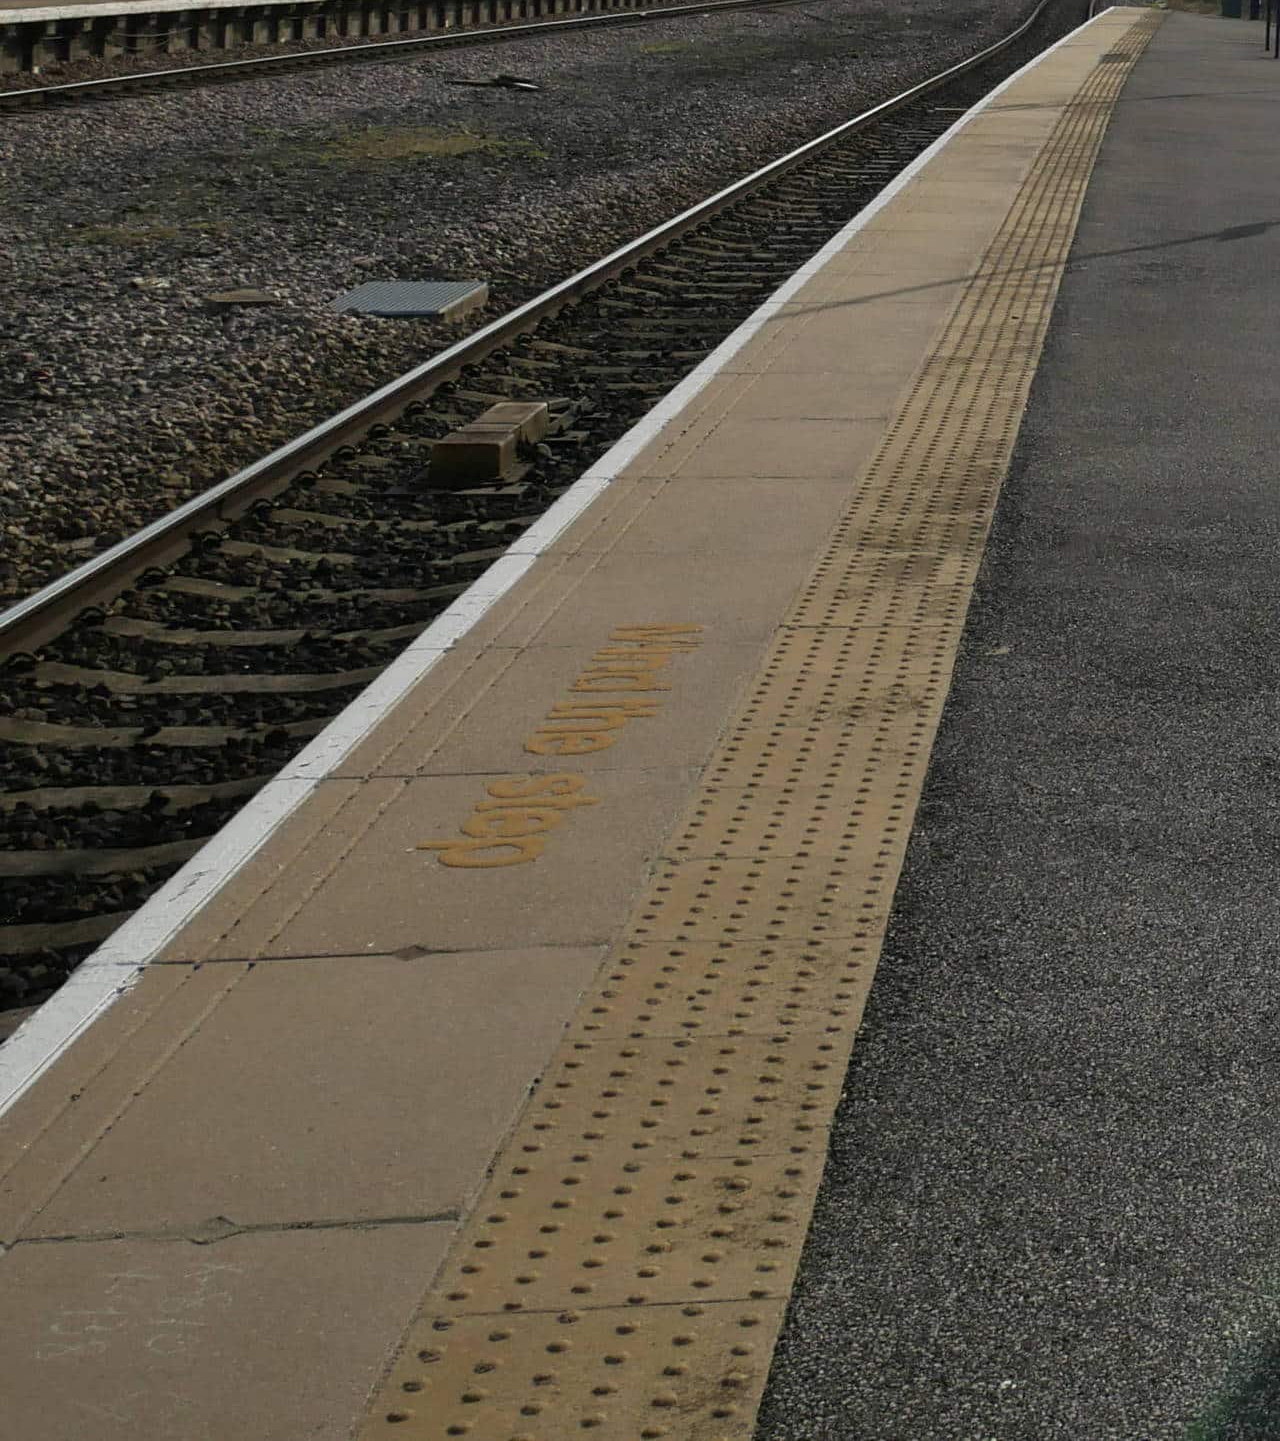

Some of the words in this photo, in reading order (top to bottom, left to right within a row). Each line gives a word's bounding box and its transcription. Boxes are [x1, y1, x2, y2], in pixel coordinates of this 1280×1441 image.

[567, 622, 704, 693] Mind
[522, 699, 668, 756] the
[415, 772, 601, 869] step
